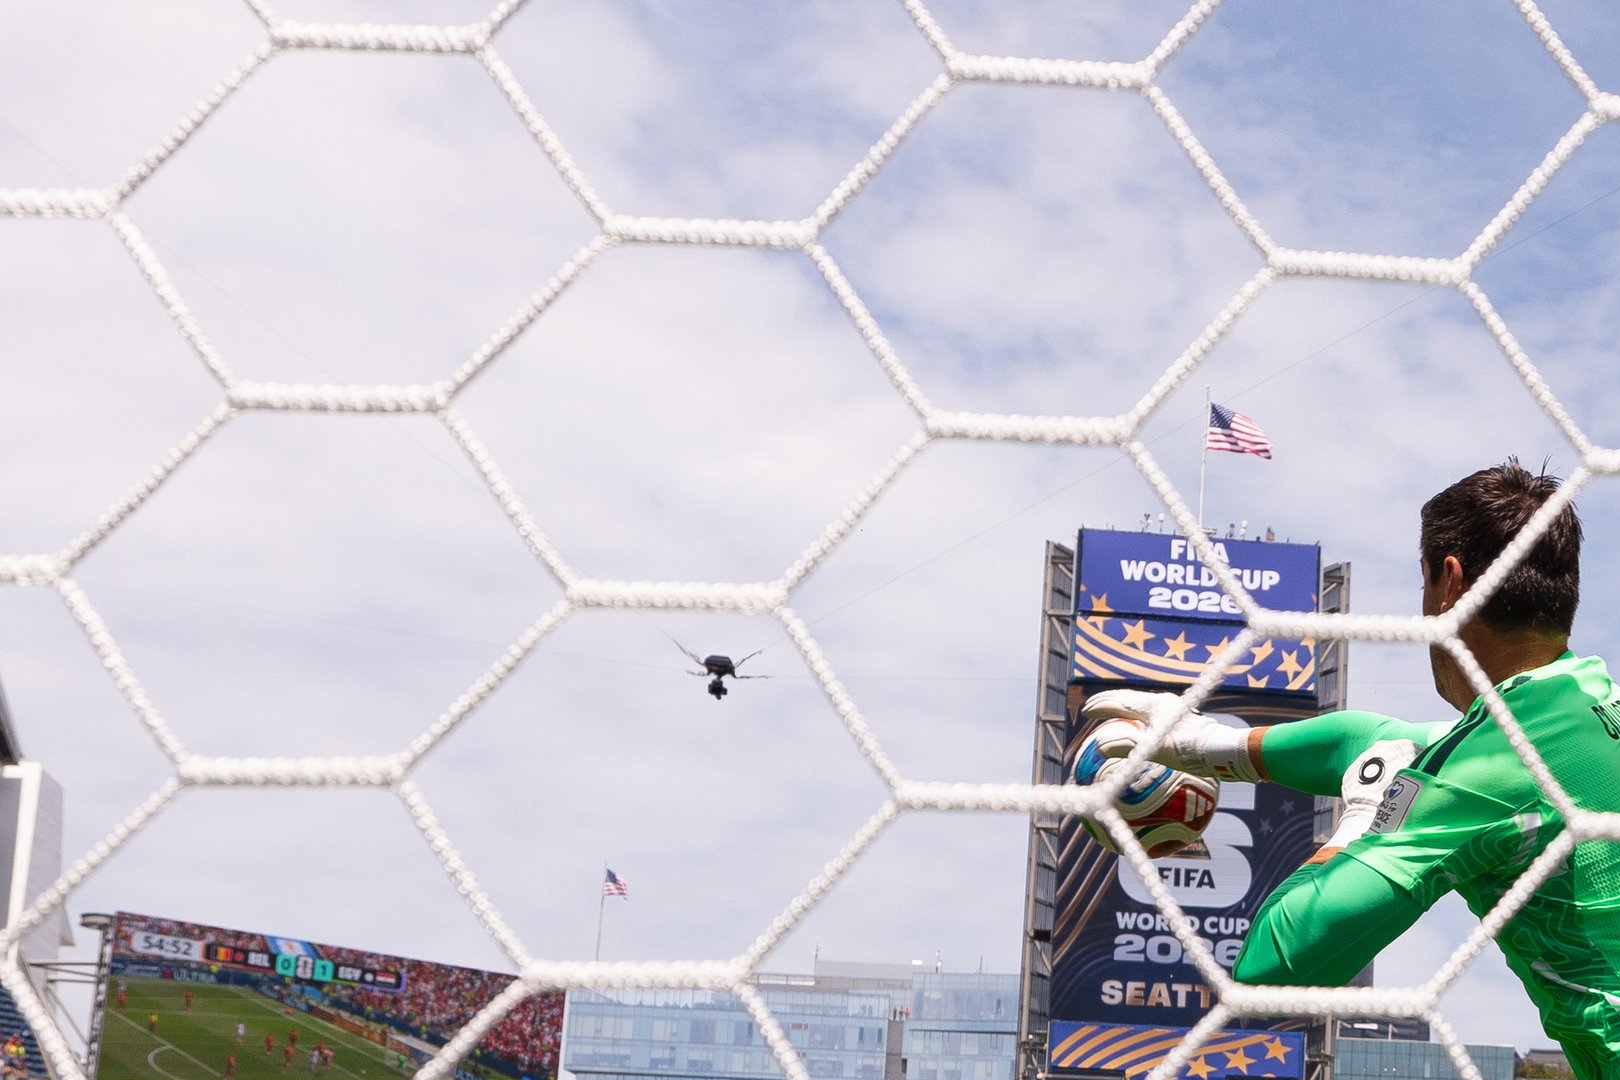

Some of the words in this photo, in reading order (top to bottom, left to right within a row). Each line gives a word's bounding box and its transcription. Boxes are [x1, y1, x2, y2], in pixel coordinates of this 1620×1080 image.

[1171, 539, 1229, 563] FIA
[1120, 560, 1218, 588] WORLD
[1148, 587, 1243, 614] 2026
[1158, 867, 1215, 889] FIFA
[1115, 911, 1200, 934] WORD
[1203, 916, 1250, 935] CUP
[141, 936, 194, 957] 54:52
[247, 951, 271, 967] BEL
[280, 957, 290, 971] 0
[1101, 979, 1214, 1009] SEATT
